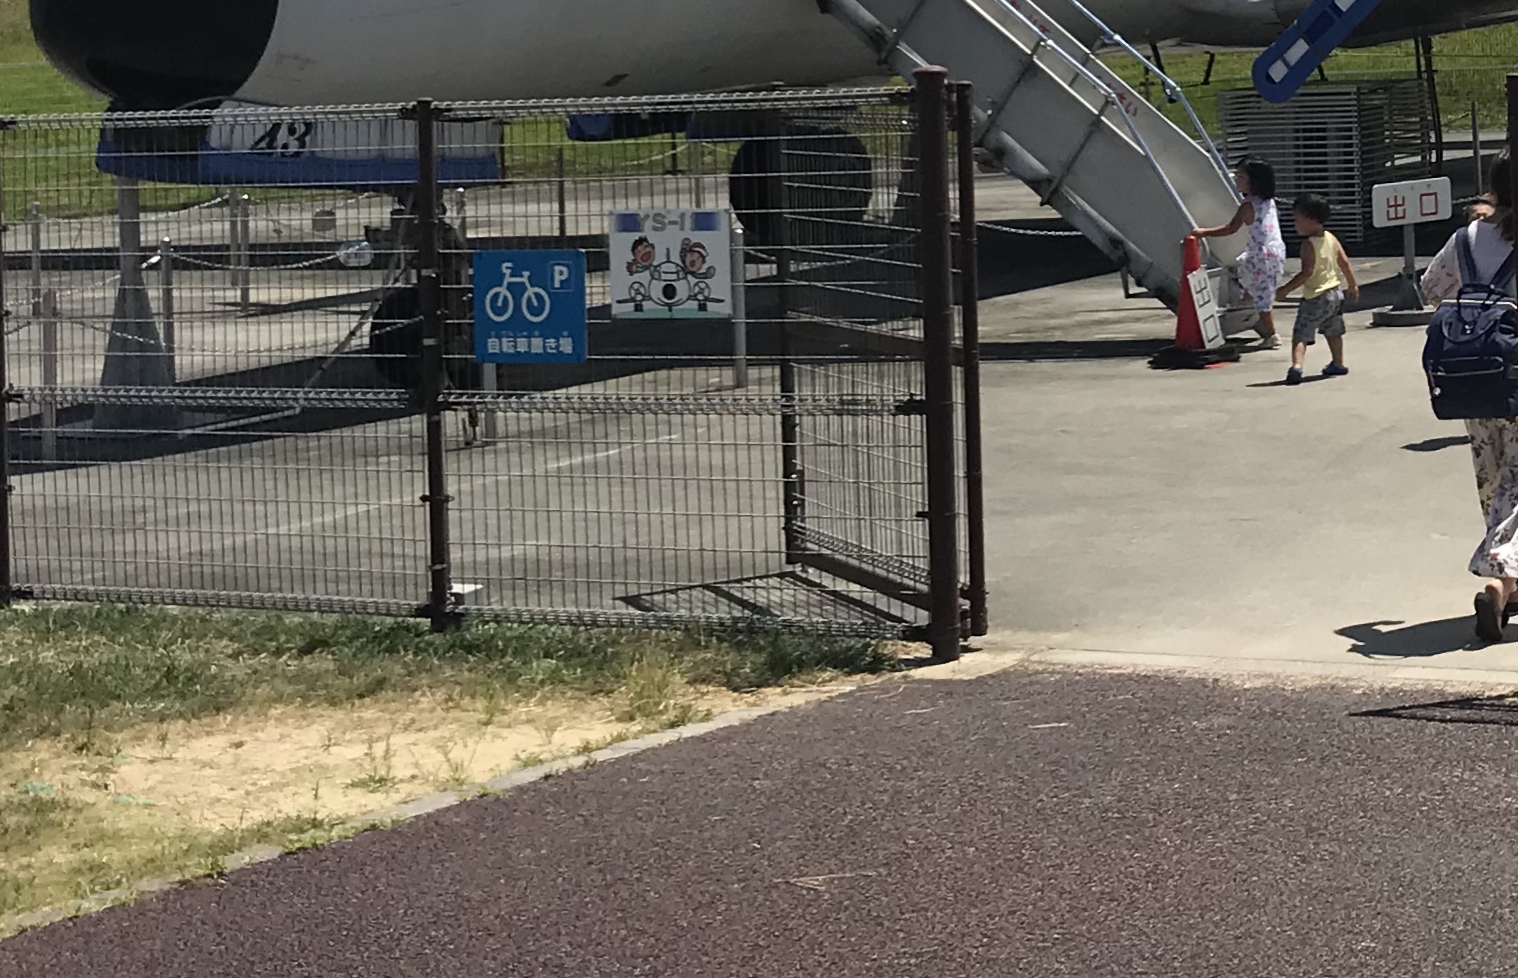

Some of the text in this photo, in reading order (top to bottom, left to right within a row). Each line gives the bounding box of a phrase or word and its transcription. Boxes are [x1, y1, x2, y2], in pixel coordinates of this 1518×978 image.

[1386, 191, 1438, 221] 出口
[637, 212, 696, 232] YS-11
[553, 265, 569, 289] P
[1193, 277, 1220, 343] 出口
[487, 337, 573, 354] 自転車置き場
